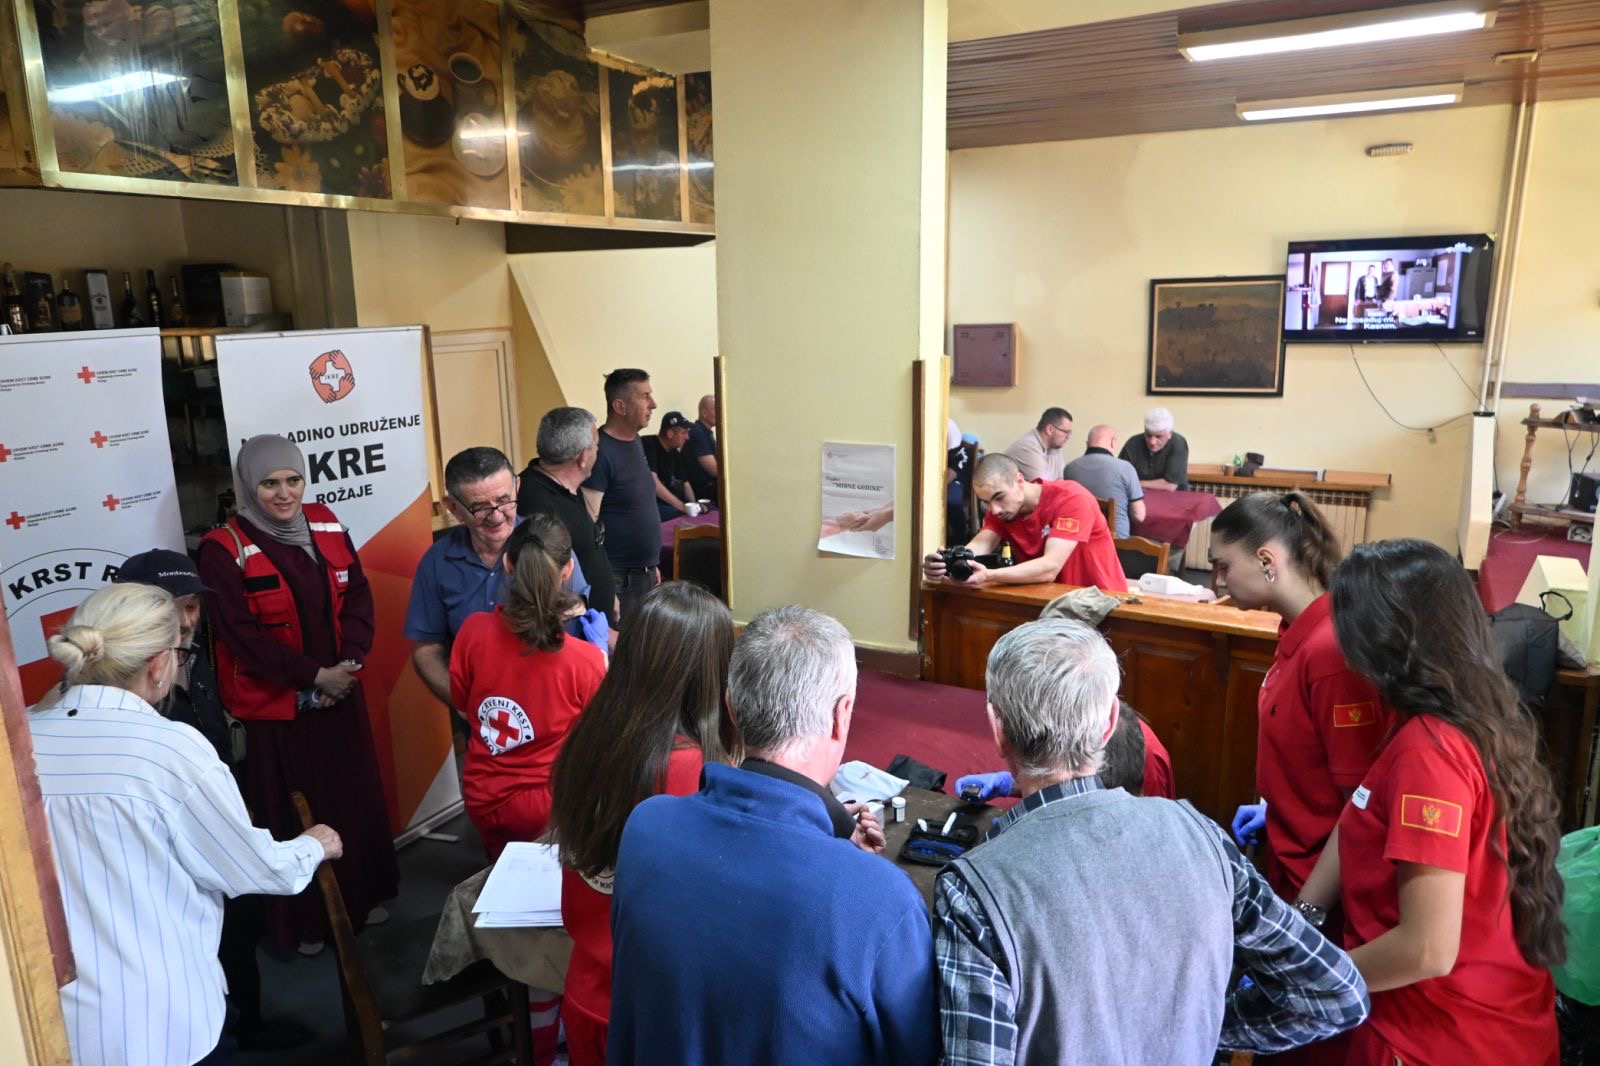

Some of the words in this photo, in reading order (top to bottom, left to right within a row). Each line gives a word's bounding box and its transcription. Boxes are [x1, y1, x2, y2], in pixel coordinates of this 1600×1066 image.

[339, 414, 420, 436] UDRUŽENJE
[307, 443, 386, 484] KRE
[316, 483, 373, 505] ROŽAJE
[8, 562, 92, 600] KRST
[101, 564, 121, 582] R
[481, 699, 509, 714] CRVENI
[512, 705, 530, 730] KRST
